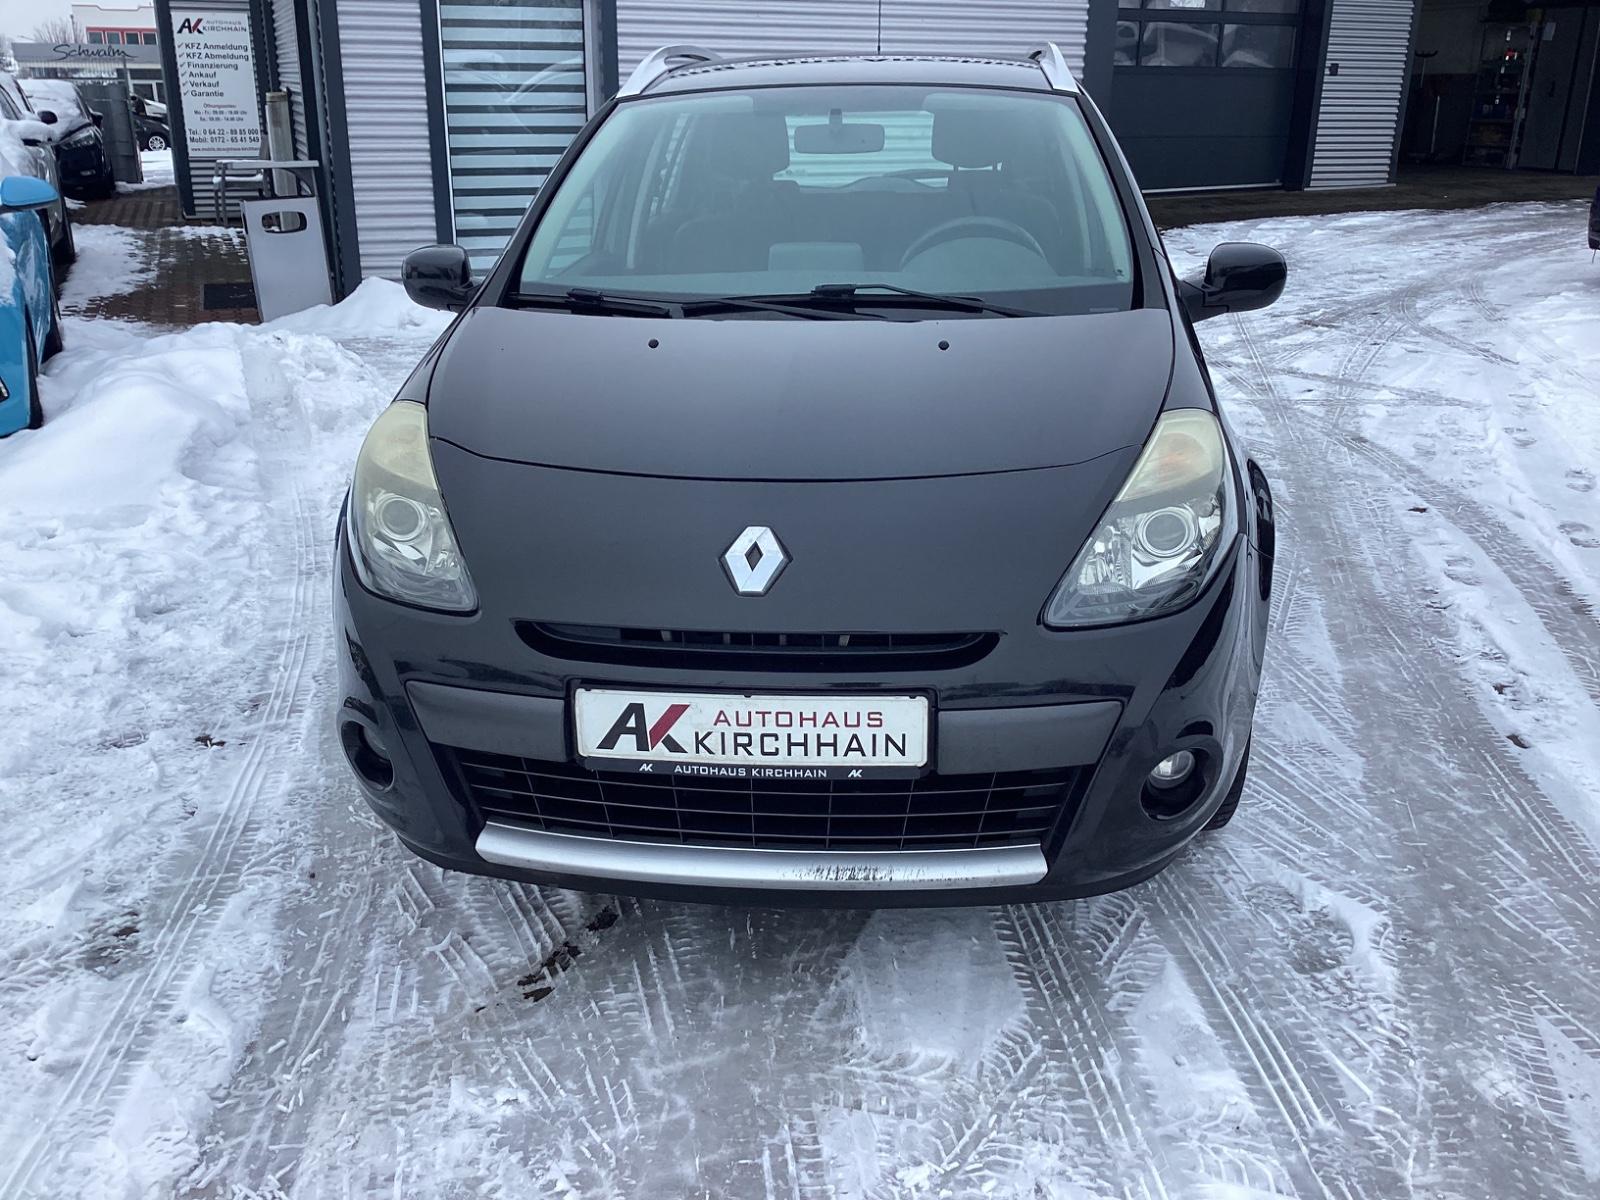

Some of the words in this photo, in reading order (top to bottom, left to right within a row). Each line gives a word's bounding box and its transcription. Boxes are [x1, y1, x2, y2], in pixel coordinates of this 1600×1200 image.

[177, 17, 203, 34] AK
[53, 44, 138, 60] Schwalm
[185, 42, 202, 50] KFZ
[203, 42, 248, 52] Anmeldung
[186, 52, 202, 60] KFZ
[204, 52, 249, 61] Abmeldung
[187, 61, 239, 71] Finanzierung
[188, 71, 217, 79] Ankauf
[189, 80, 220, 88] Verkauf
[190, 89, 224, 97] Garantie
[713, 710, 884, 728] AUTOHAUS
[595, 702, 691, 754] AK
[694, 731, 907, 757] KIRCHHAIN
[639, 763, 653, 772] AK
[674, 764, 746, 777] AUTOHAUS
[751, 767, 828, 778] KIRCHHAIN
[847, 769, 863, 778] AK
